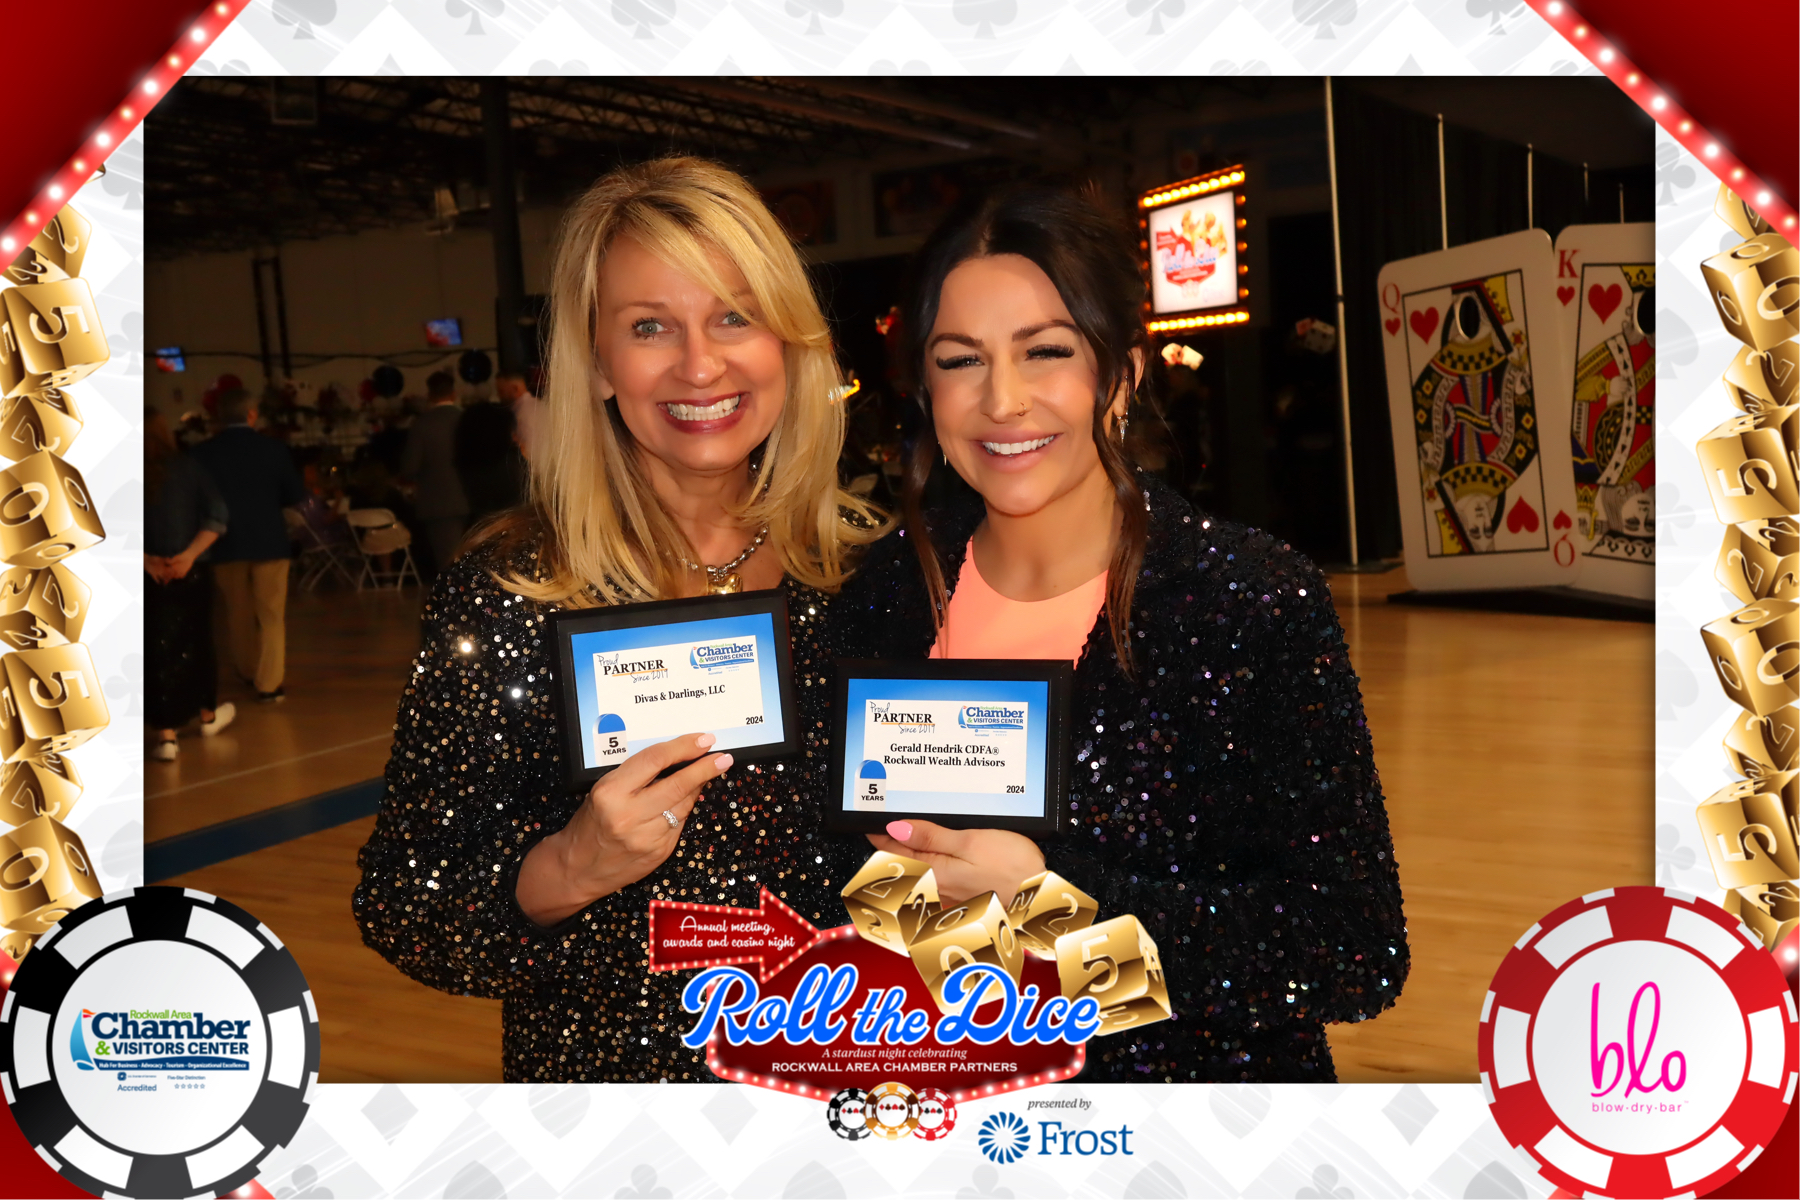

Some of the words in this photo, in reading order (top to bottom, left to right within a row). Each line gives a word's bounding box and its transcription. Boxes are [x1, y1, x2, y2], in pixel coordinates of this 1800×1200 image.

[1558, 249, 1581, 279] K
[1382, 283, 1401, 314] Q
[1554, 533, 1576, 568] Q
[697, 643, 753, 657] Chamber
[597, 653, 619, 666] Proud
[705, 654, 731, 663] VISITORS
[603, 659, 665, 675] PARTNER
[630, 671, 650, 683] Since
[634, 692, 659, 704] Divas
[660, 692, 667, 701] &
[668, 687, 707, 700] Darlings,
[708, 684, 726, 695] LLC
[870, 701, 890, 713] Proud
[966, 706, 1024, 718] Chamber
[745, 715, 764, 725] 2024
[874, 713, 933, 723] PARTNER
[898, 722, 917, 734] Since
[608, 737, 619, 748] 5
[890, 743, 922, 753] Gerald
[923, 744, 963, 754] Hendrik
[602, 747, 627, 756] YEARS
[884, 755, 926, 765] Rockwall
[928, 756, 962, 766] Wealth
[963, 757, 1006, 767] Advisors
[868, 784, 878, 795] 5
[1006, 785, 1025, 794] 2024
